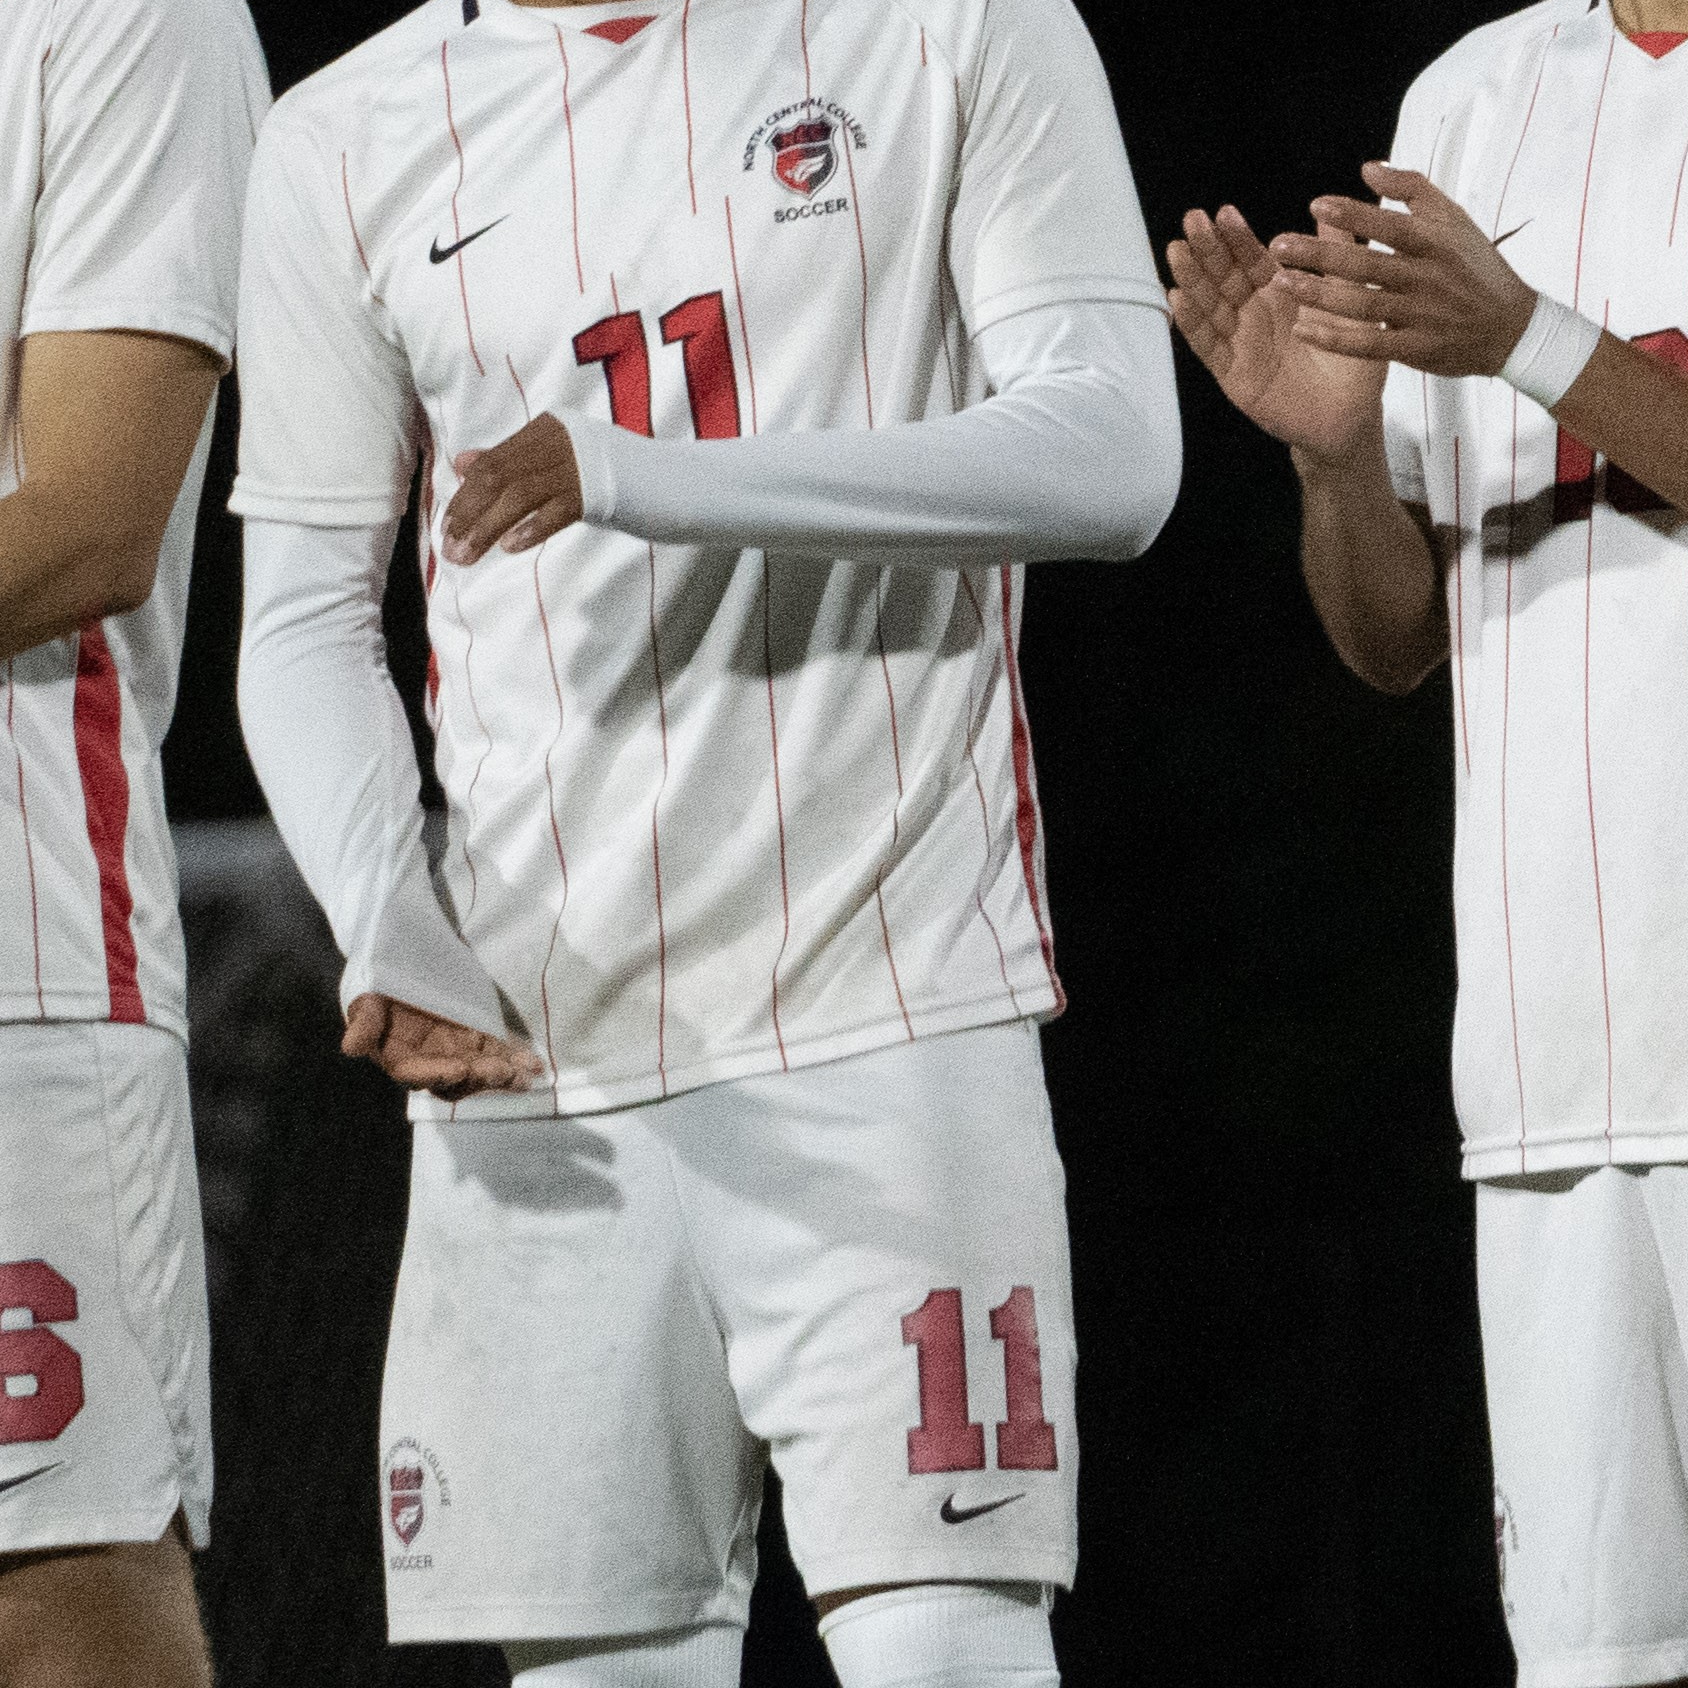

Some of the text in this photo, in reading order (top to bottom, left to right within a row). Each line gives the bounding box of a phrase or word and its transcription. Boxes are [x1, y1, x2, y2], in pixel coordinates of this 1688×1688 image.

[774, 197, 849, 224] SOCCER
[572, 289, 742, 440] 11
[901, 1286, 1059, 1476] 11
